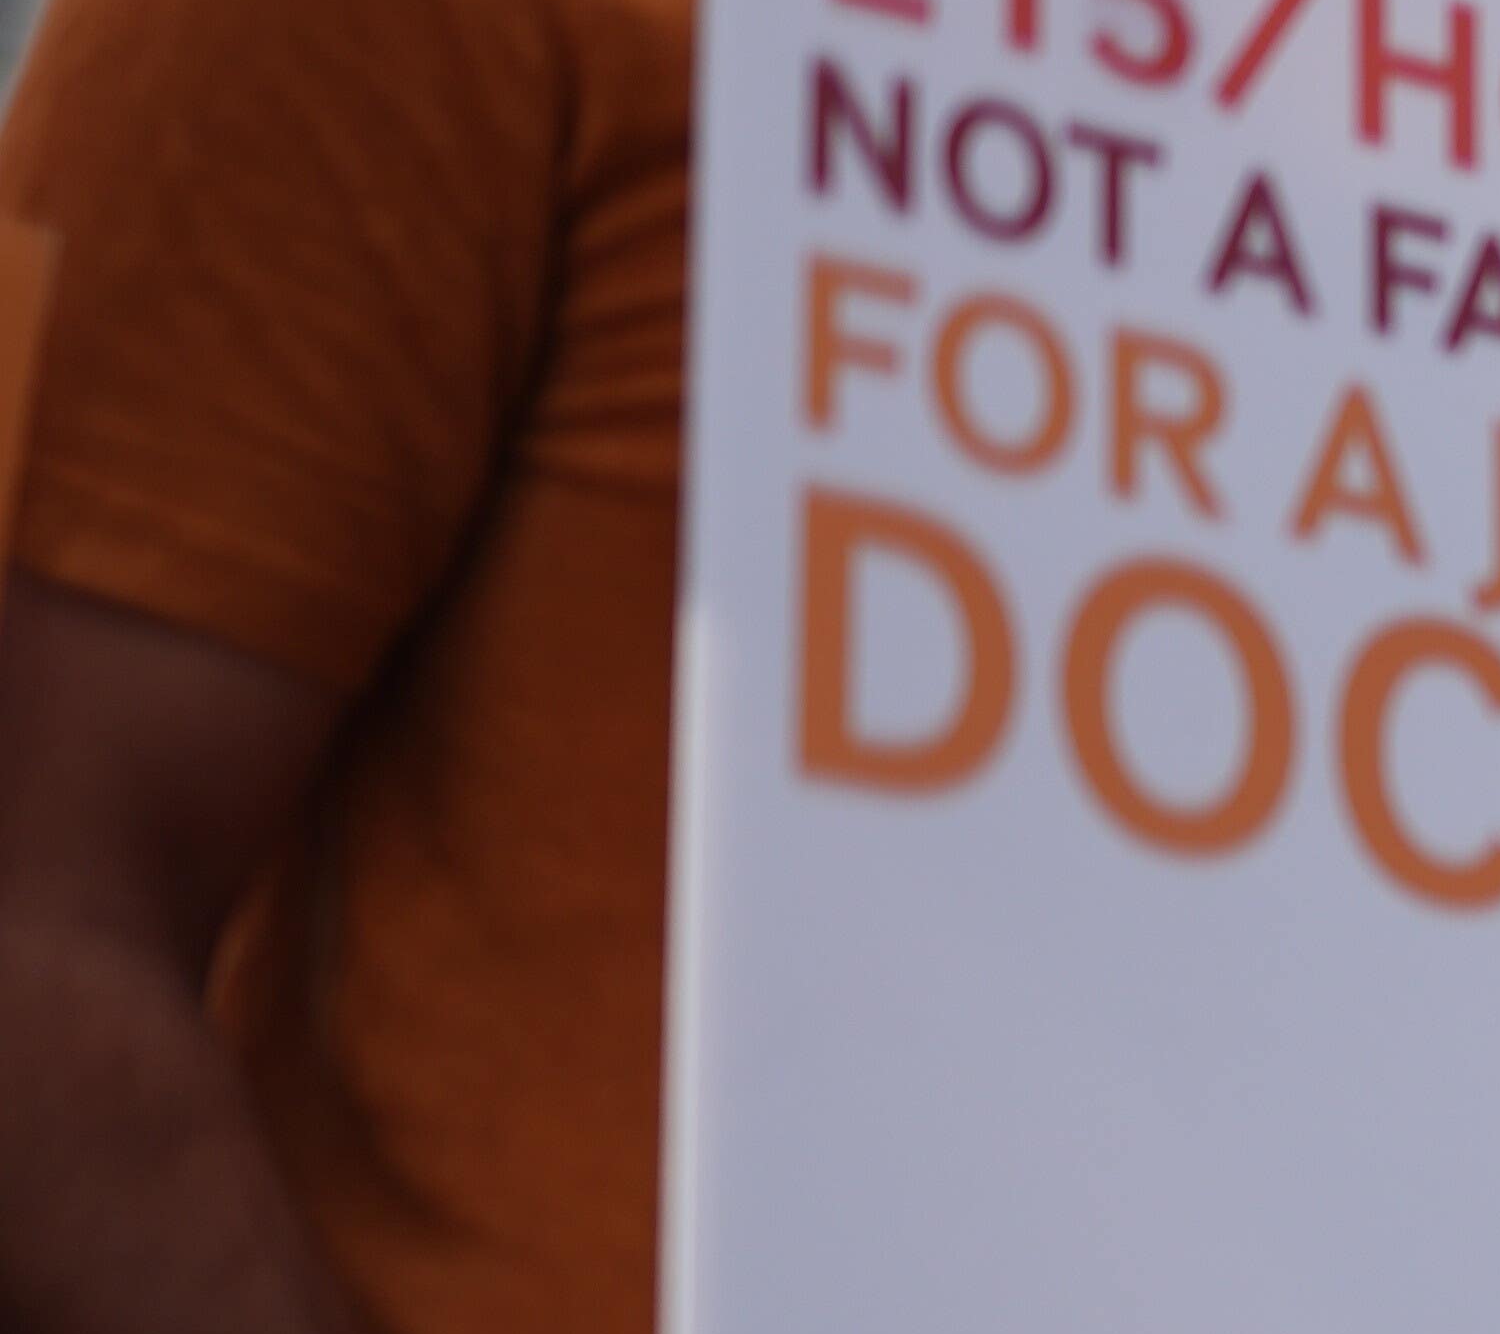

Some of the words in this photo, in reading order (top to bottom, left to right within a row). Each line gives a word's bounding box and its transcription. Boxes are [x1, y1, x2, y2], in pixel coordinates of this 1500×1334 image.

[805, 55, 1162, 268] NOT
[1206, 171, 1316, 317] A
[801, 254, 1229, 521] FOR
[1291, 384, 1425, 567] A
